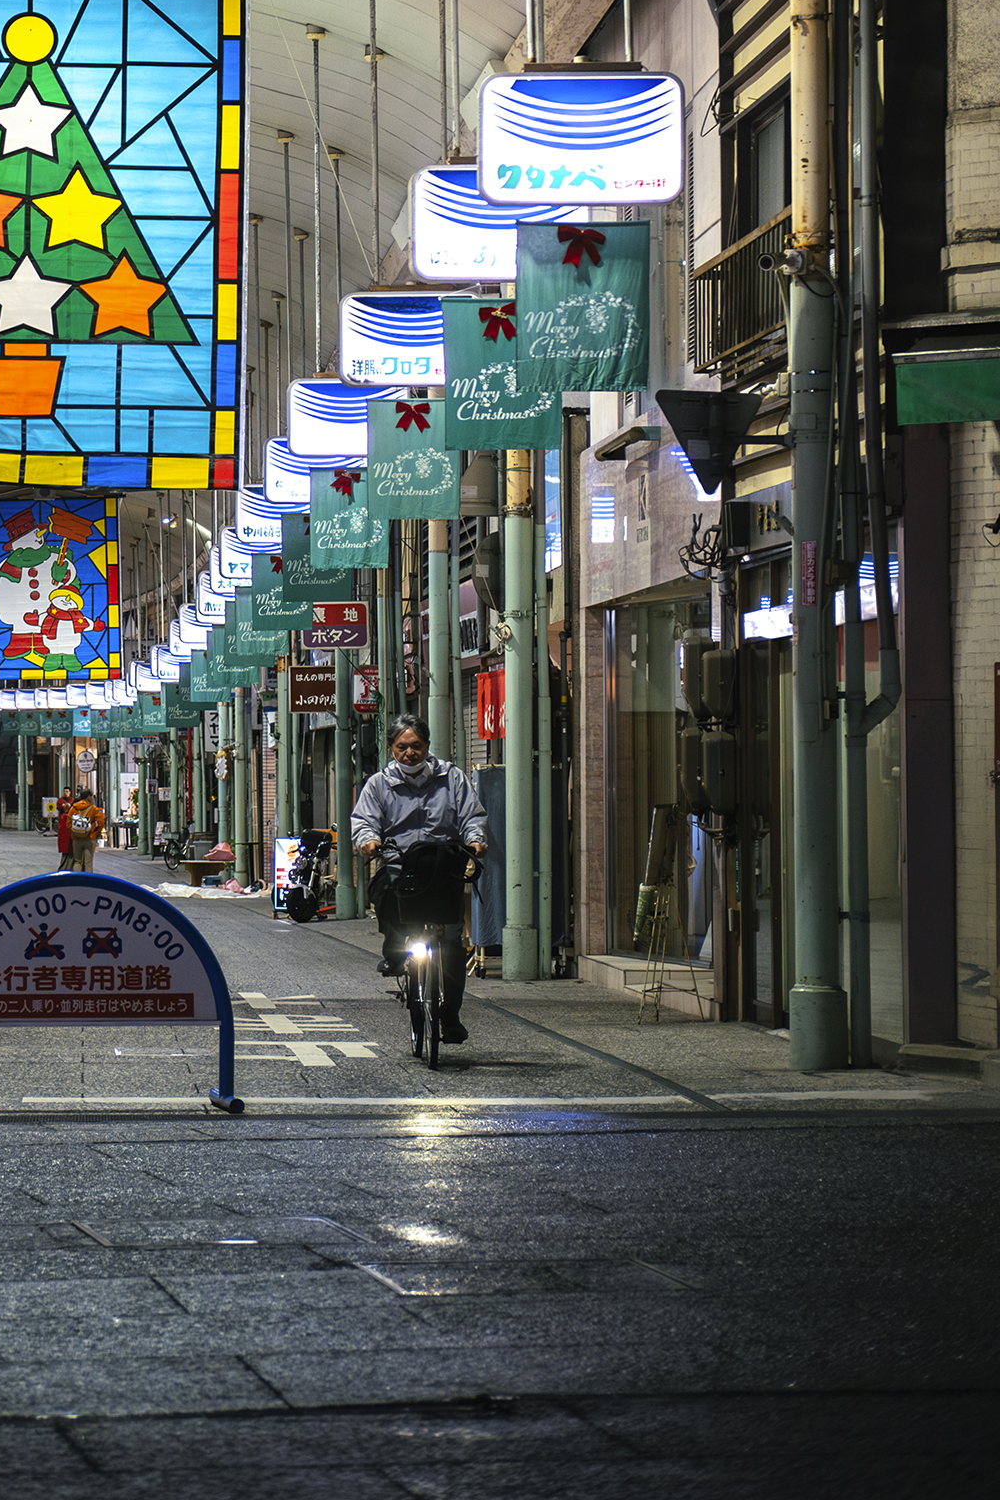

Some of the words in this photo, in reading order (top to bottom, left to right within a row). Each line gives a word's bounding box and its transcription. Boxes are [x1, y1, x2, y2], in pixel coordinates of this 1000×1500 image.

[497, 164, 606, 190] ワタナベ
[614, 178, 666, 189] センター街
[524, 311, 579, 338] Merry
[529, 336, 617, 358] Christmas
[451, 378, 500, 403] Merry
[457, 400, 530, 421] Christmas
[373, 462, 411, 481] Merry
[377, 480, 437, 496] Christmas
[314, 520, 347, 537] Merry
[317, 536, 367, 549] Christmas
[287, 560, 315, 576] Merry
[807, 543, 815, 604] 防犯カメラ作動中
[289, 574, 338, 585] Christmas
[256, 594, 282, 607] Merry
[258, 606, 300, 616] Christmas
[312, 629, 358, 643] ボタン
